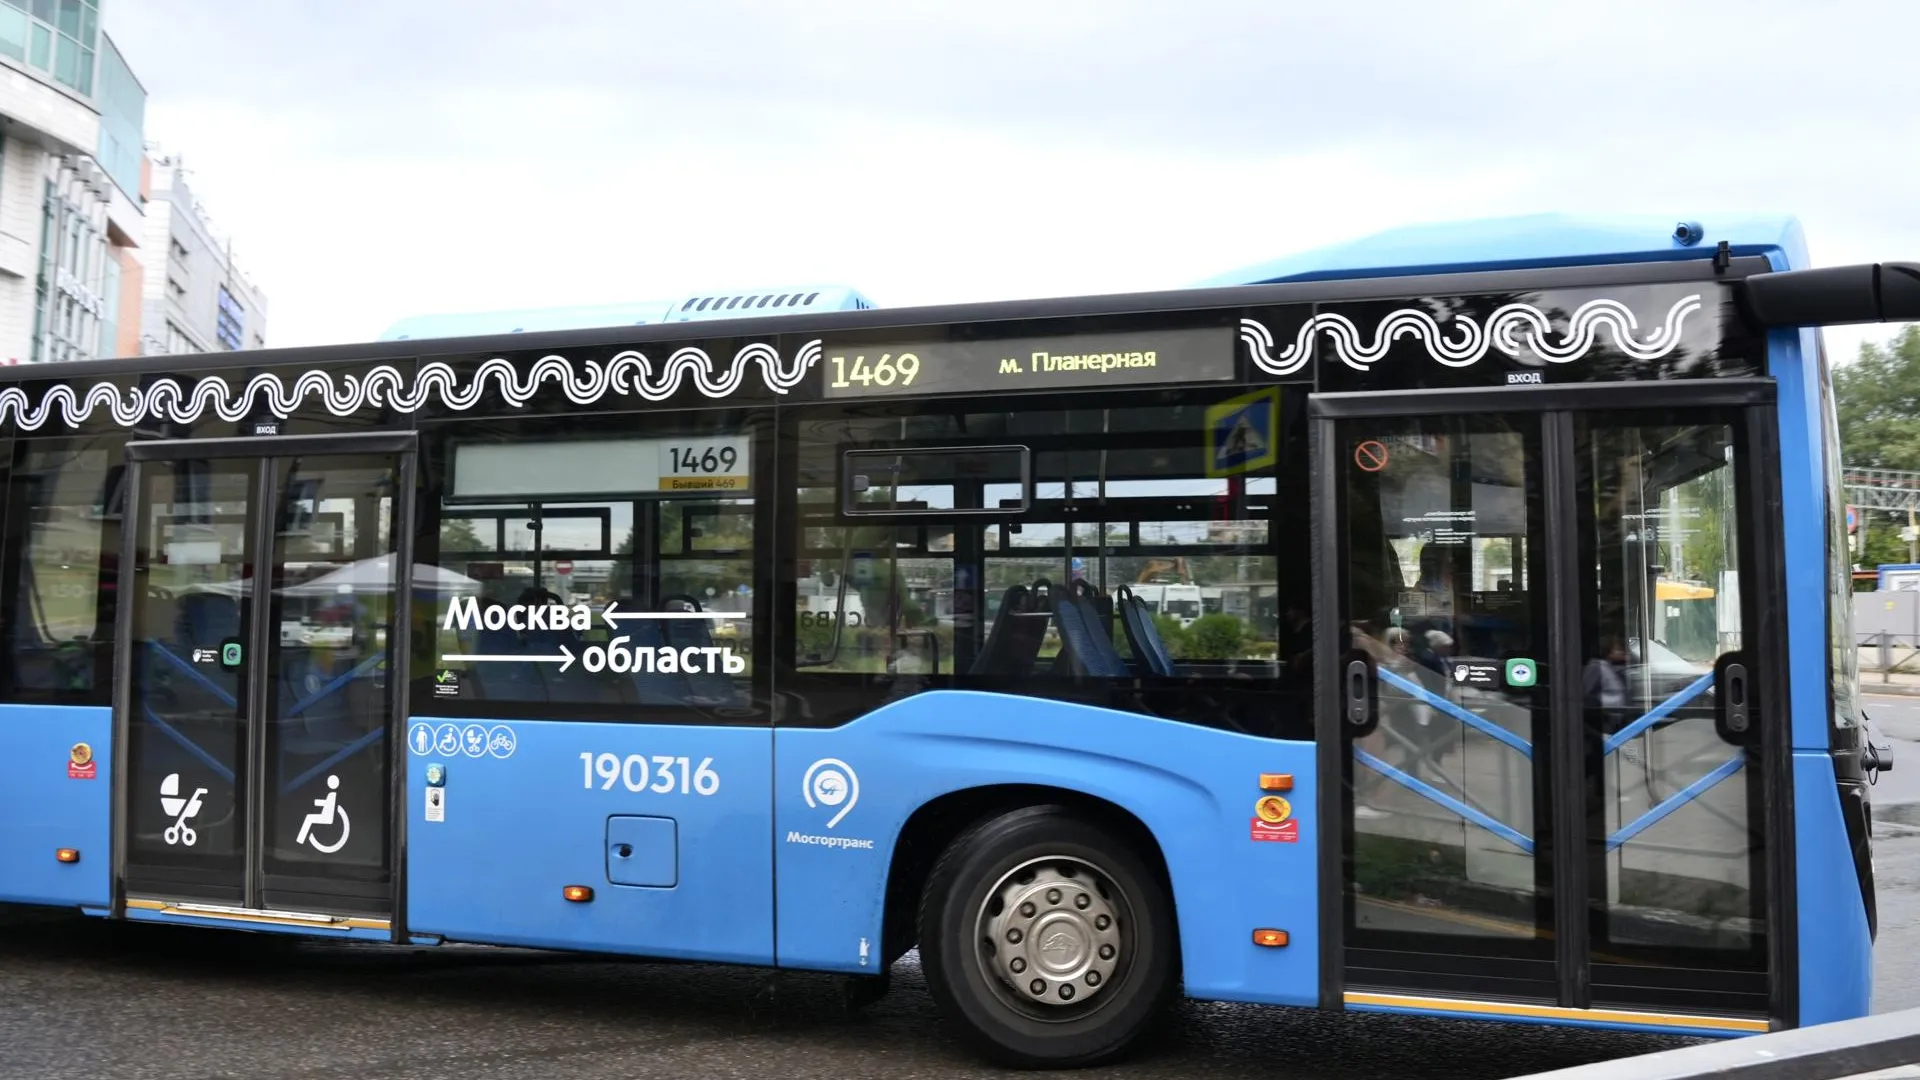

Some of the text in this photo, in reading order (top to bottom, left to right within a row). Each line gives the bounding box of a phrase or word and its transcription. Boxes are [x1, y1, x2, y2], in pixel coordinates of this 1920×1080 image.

[831, 353, 920, 388] 1469
[998, 351, 1157, 374] м. Планерная
[1507, 372, 1542, 384] ВХОД
[256, 425, 276, 435] ВХОД
[669, 446, 737, 474] 1469
[672, 478, 736, 490] Бывший 469
[443, 595, 592, 631] Москва
[582, 635, 746, 674] область
[579, 752, 720, 796] 190316
[786, 831, 875, 850] Мосгортранс
